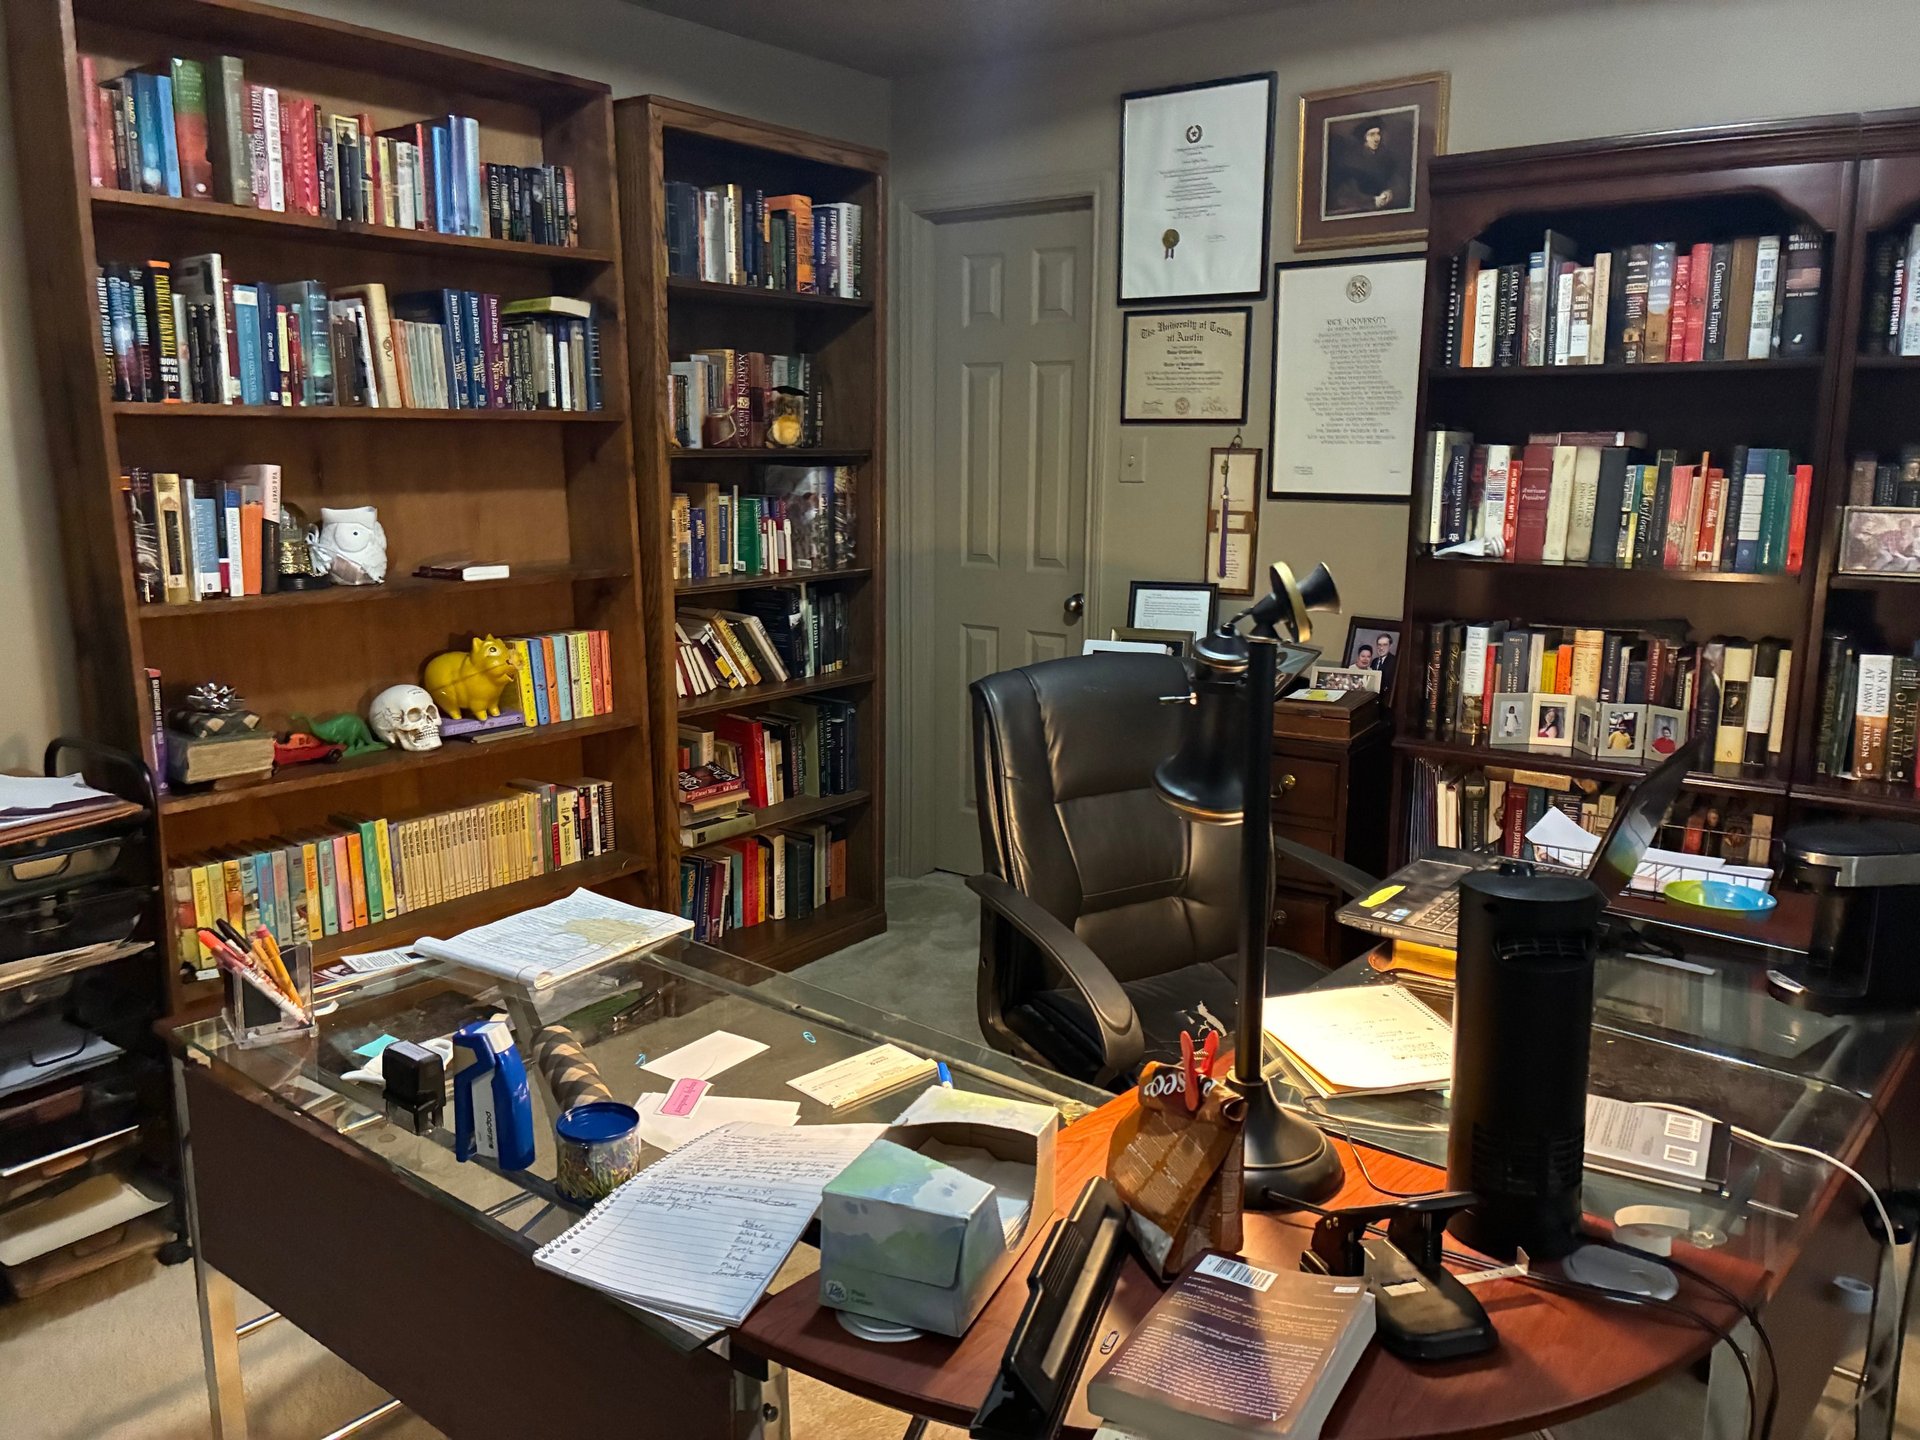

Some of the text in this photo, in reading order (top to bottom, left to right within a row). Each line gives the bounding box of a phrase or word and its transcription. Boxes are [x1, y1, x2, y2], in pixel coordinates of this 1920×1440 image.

[96, 276, 107, 313] PATRICIA
[133, 285, 149, 346] PATRICIA CORNWELL
[154, 274, 177, 357] PATRICIA CORNWELL
[1346, 316, 1386, 325] UNIVERSITY
[1707, 262, 1726, 344] Comanche Empire
[1177, 331, 1204, 342] Austin
[1863, 668, 1874, 712] AT DAWN
[1875, 668, 1888, 714] AN ARMY
[1889, 692, 1907, 767] OF BATTLE
[1903, 701, 1918, 760] THE DAY
